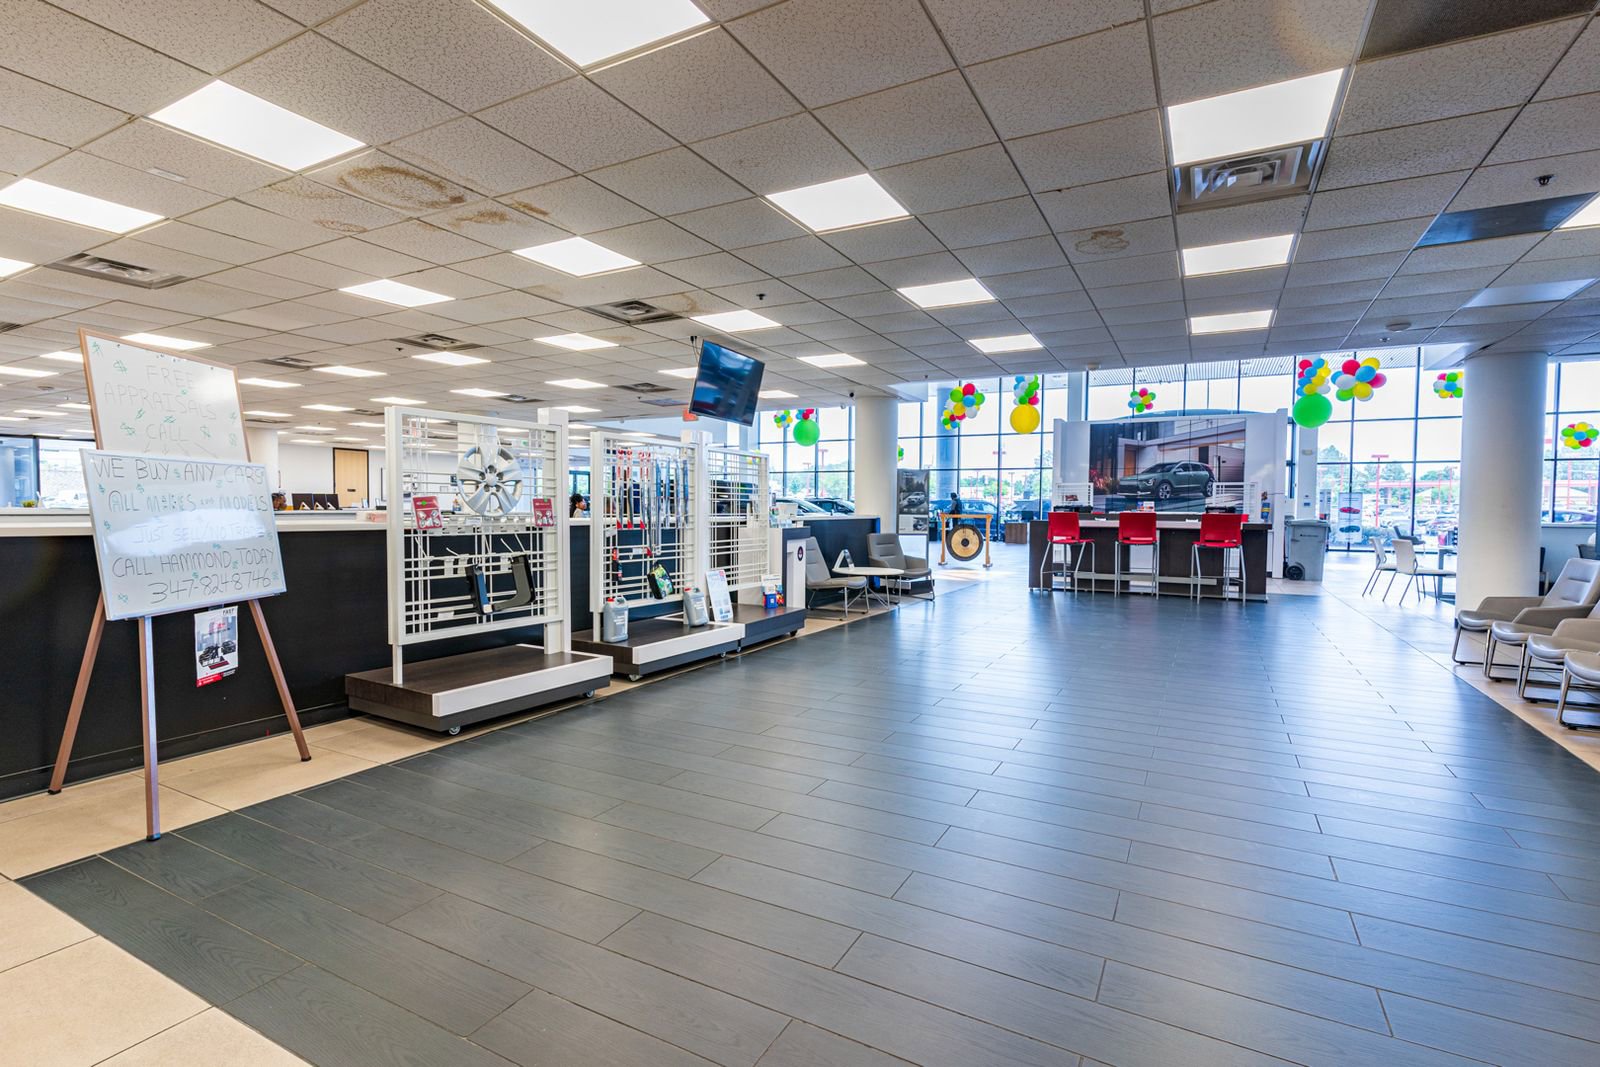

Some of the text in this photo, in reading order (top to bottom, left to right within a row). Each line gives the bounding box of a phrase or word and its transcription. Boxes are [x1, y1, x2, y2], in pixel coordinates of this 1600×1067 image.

[146, 365, 194, 389] FREE
[104, 382, 217, 420] APPRAISALS
[146, 424, 190, 441] CALL
[93, 457, 264, 484] WE BUY ANY CARS
[108, 490, 140, 512] ALL
[219, 494, 268, 512] MODELS
[112, 548, 274, 577] CALL HAMMOND TODAY
